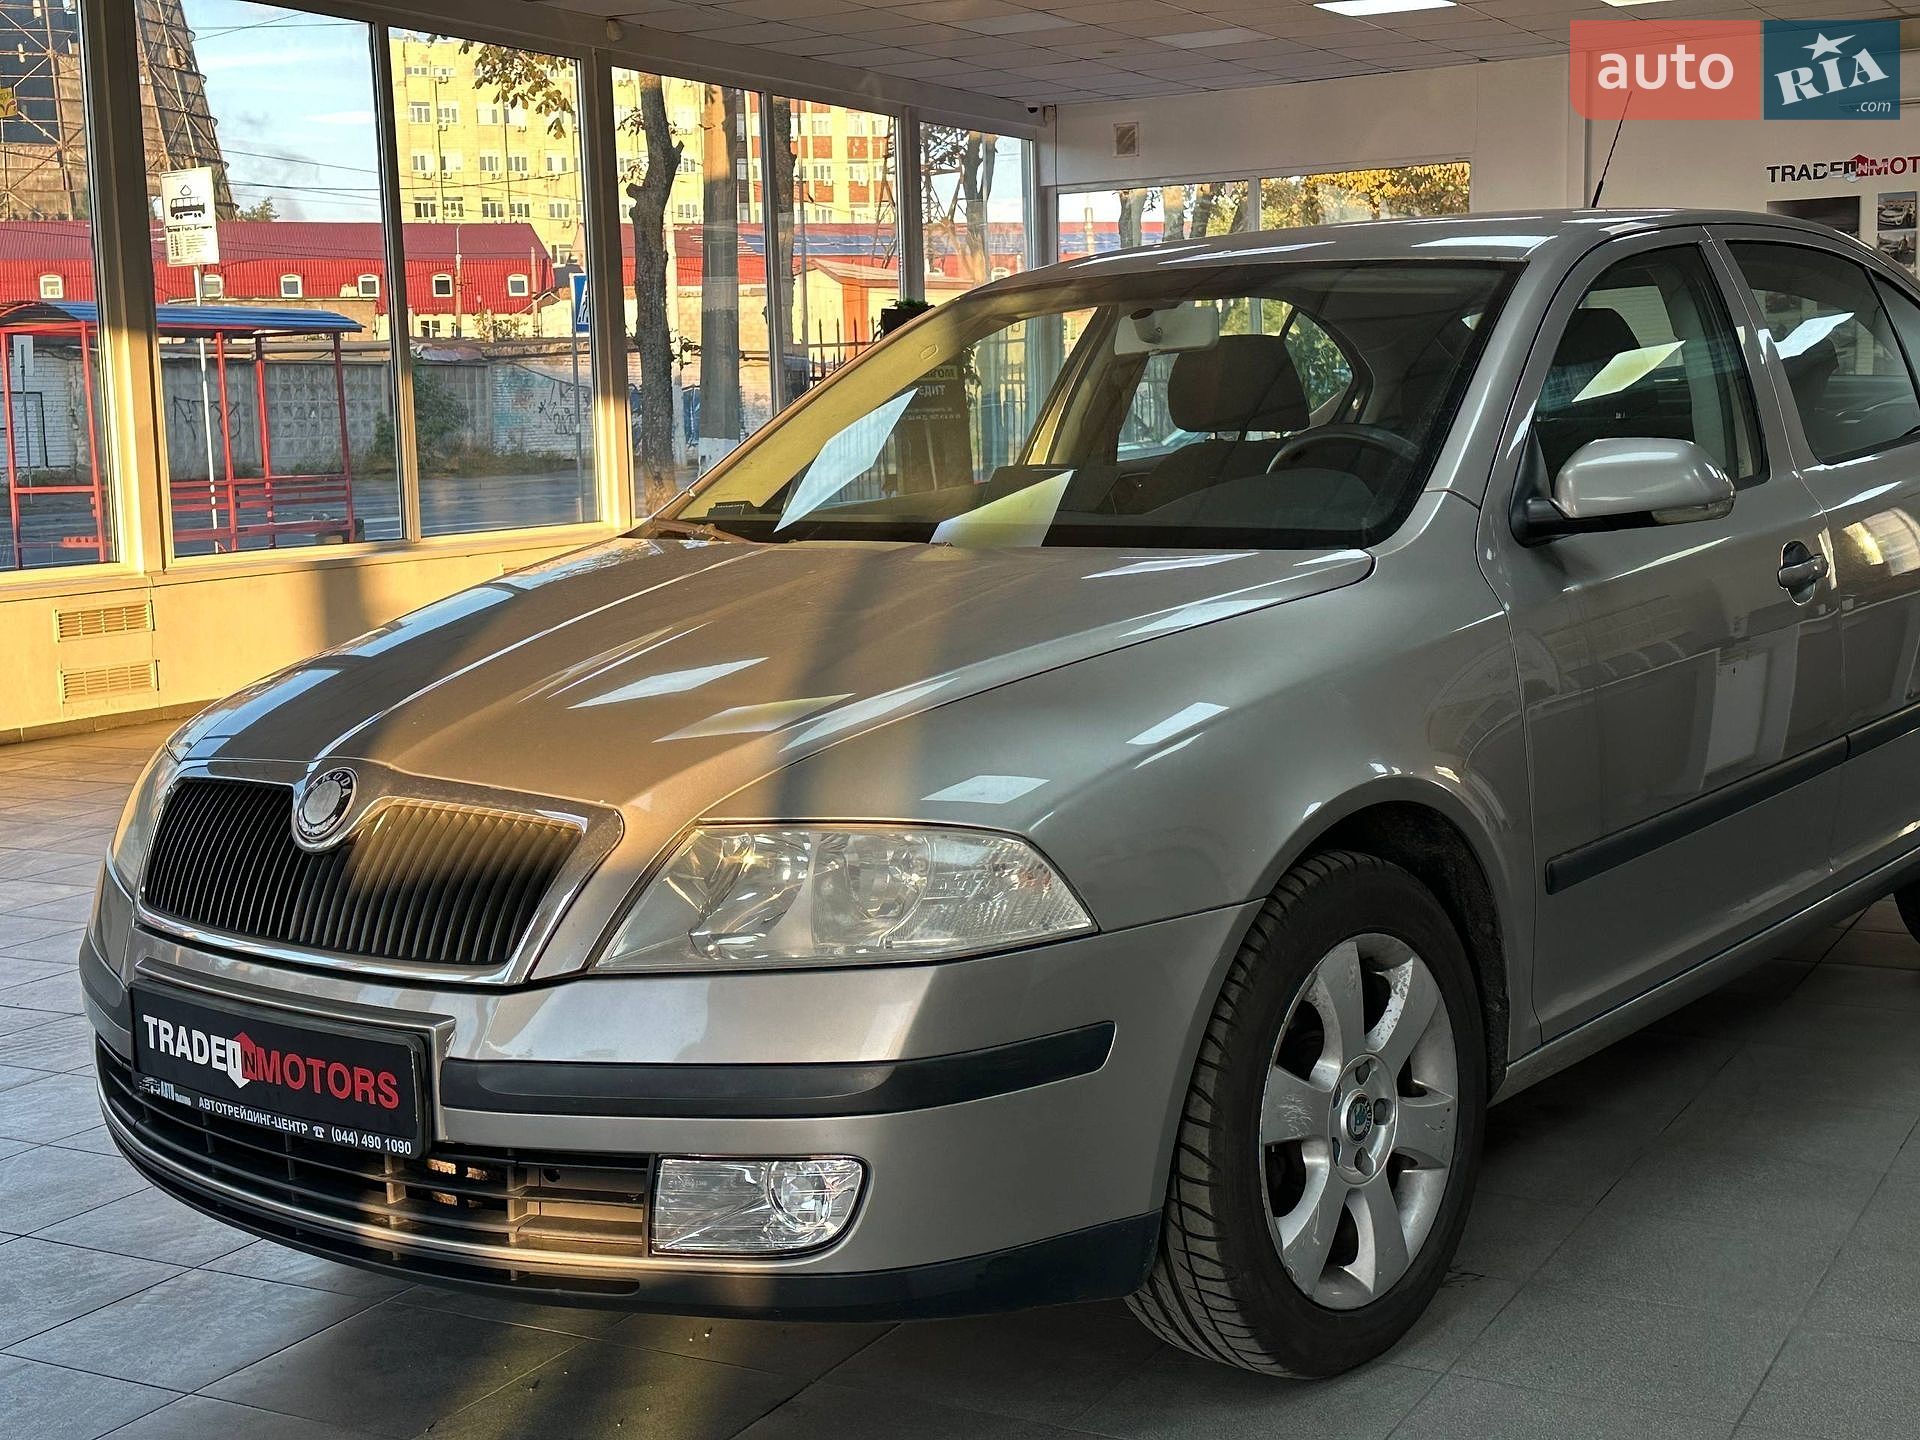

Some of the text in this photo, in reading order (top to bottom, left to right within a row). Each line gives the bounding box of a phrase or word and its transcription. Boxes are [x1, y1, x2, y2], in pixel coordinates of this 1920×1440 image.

[198, 1096, 308, 1135] АВТОТРЕЙДИНГ-ЦЕНТР
[331, 1127, 359, 1147] (044)
[361, 1133, 381, 1150] 490
[384, 1139, 412, 1155] 1090
